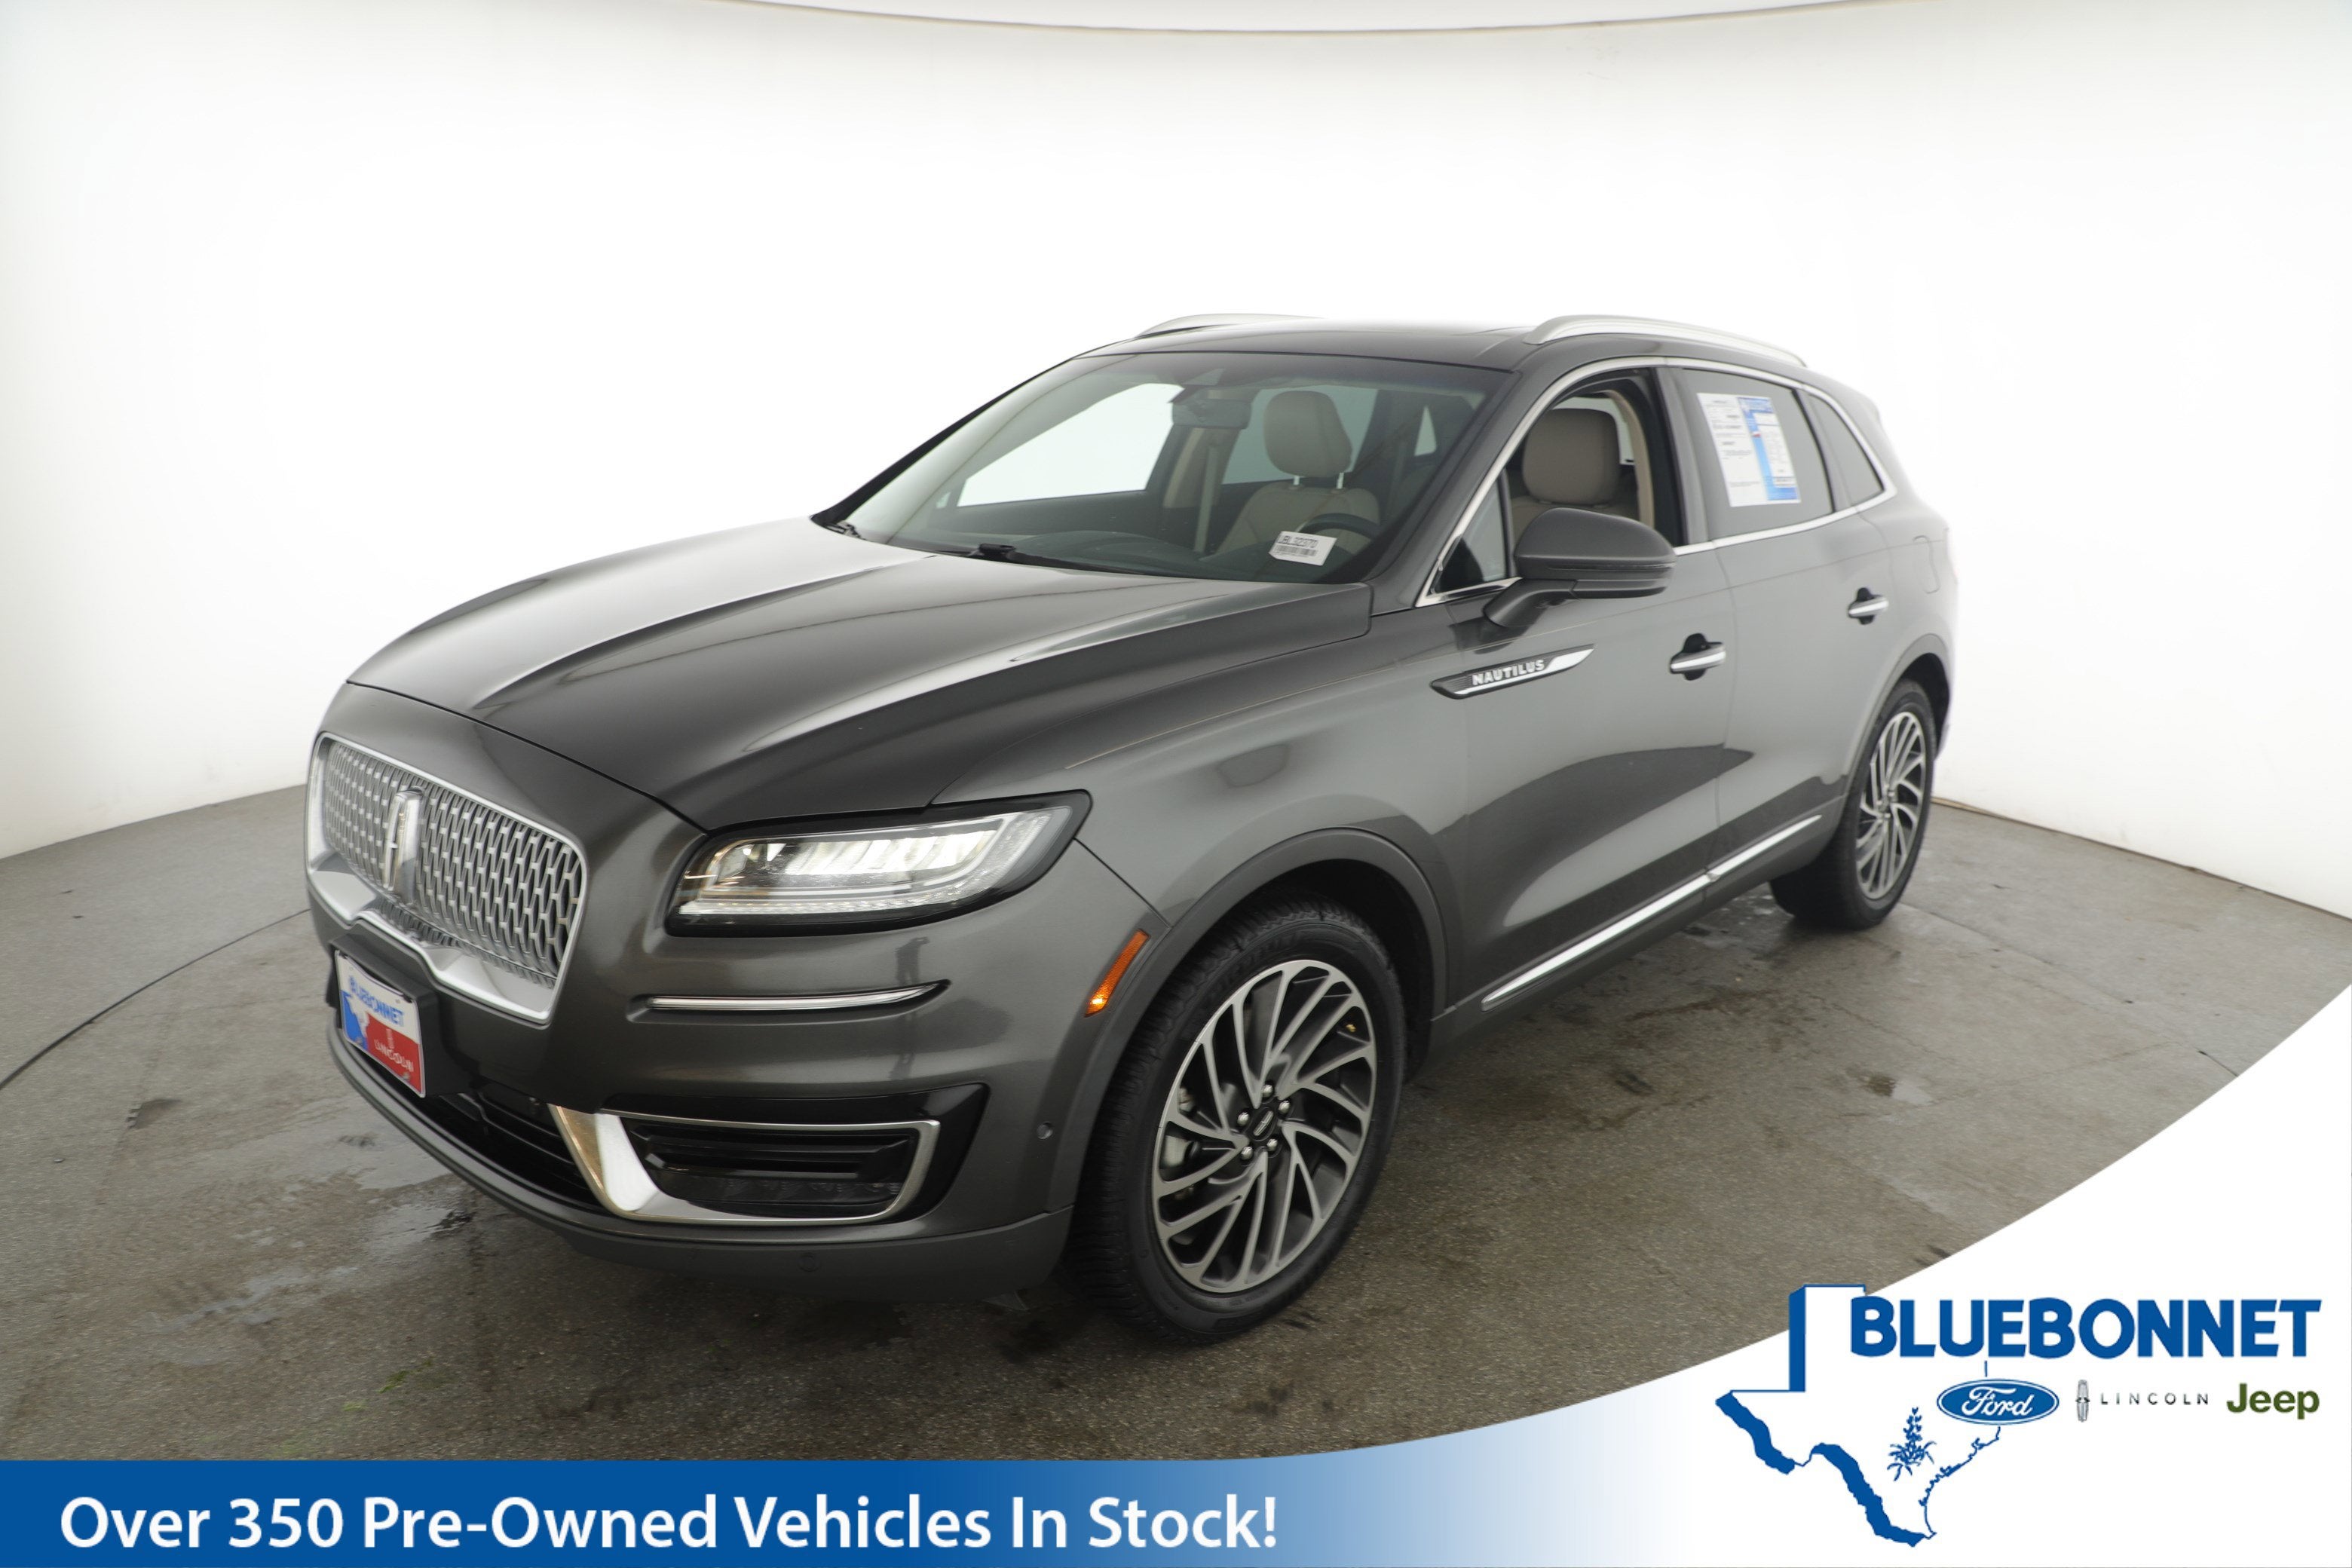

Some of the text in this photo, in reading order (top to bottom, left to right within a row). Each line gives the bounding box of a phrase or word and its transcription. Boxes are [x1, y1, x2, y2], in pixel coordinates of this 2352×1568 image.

[1472, 660, 1545, 685] NAUTILUS
[348, 976, 404, 1027] BLUEBONNET
[373, 1038, 415, 1072] LINCOLN
